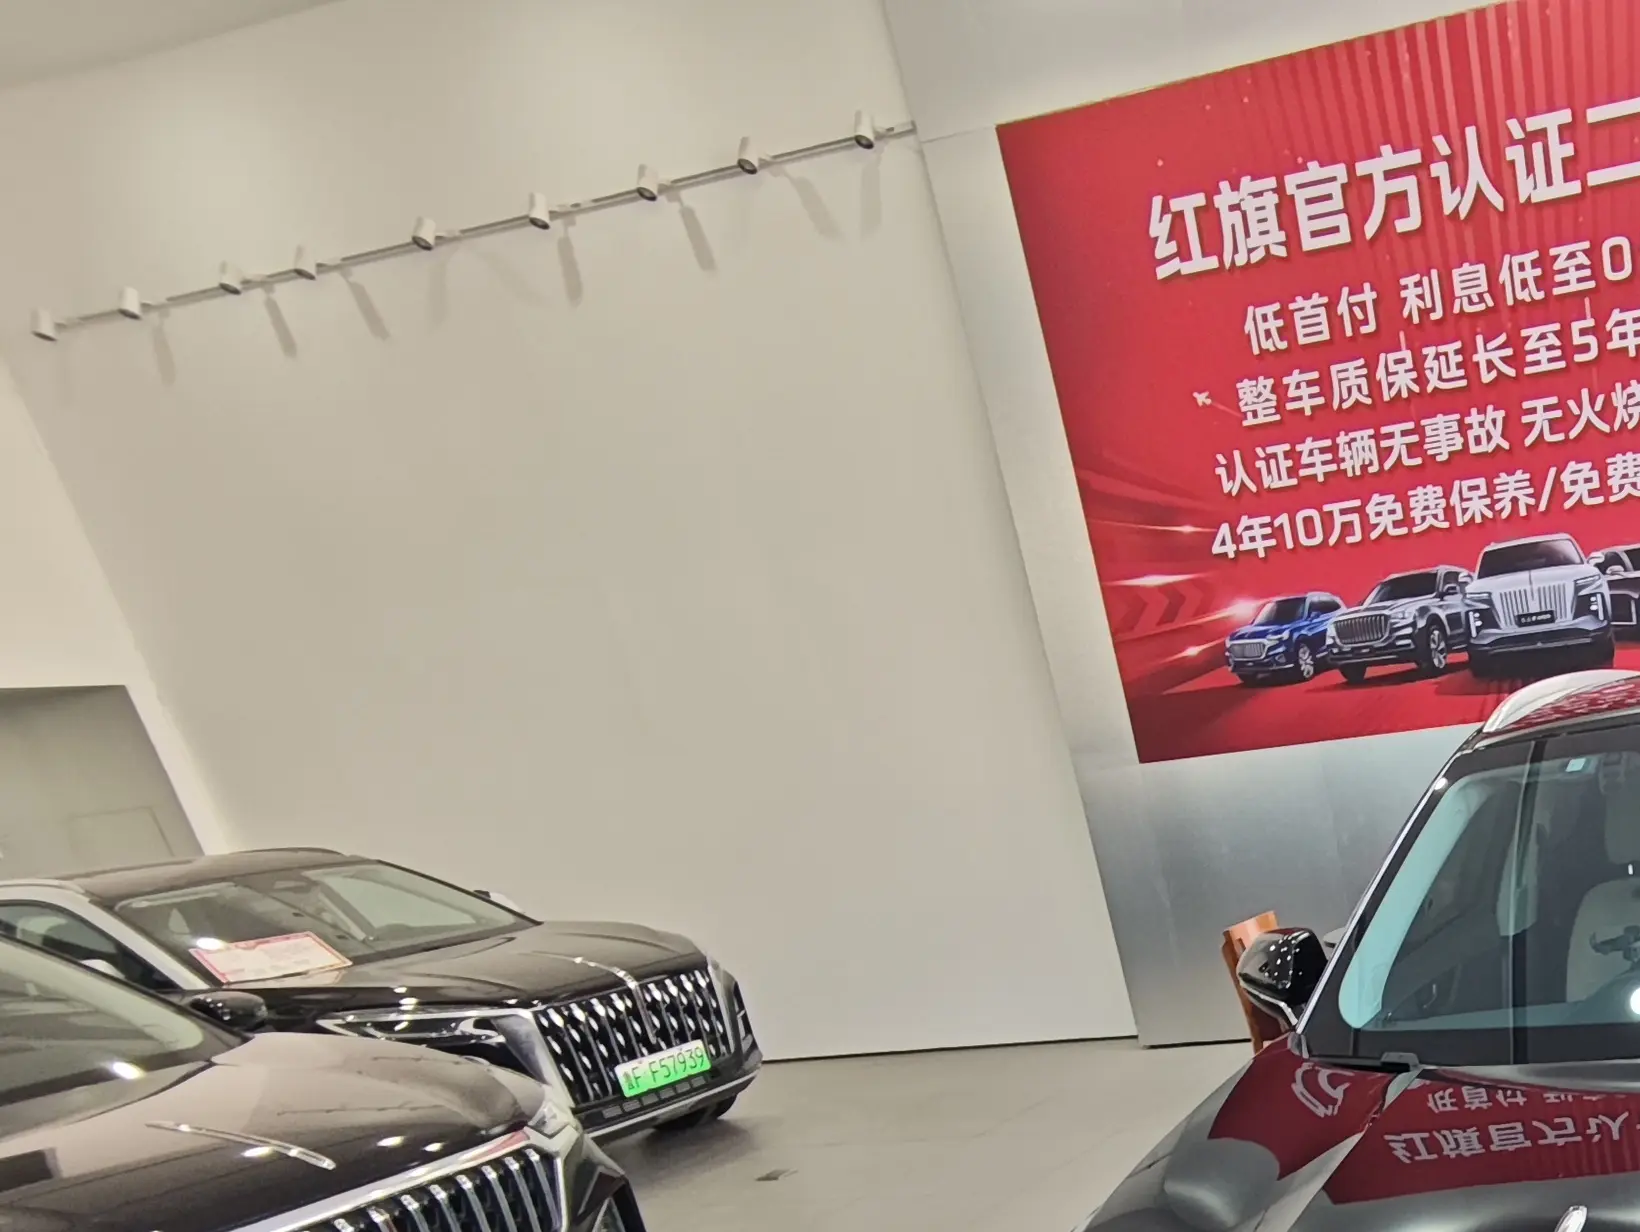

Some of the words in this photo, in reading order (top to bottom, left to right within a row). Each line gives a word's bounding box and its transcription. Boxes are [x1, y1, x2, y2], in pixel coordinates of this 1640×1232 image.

[1245, 283, 1378, 355] 低首付
[1216, 405, 1510, 497] 认证车辆无事故
